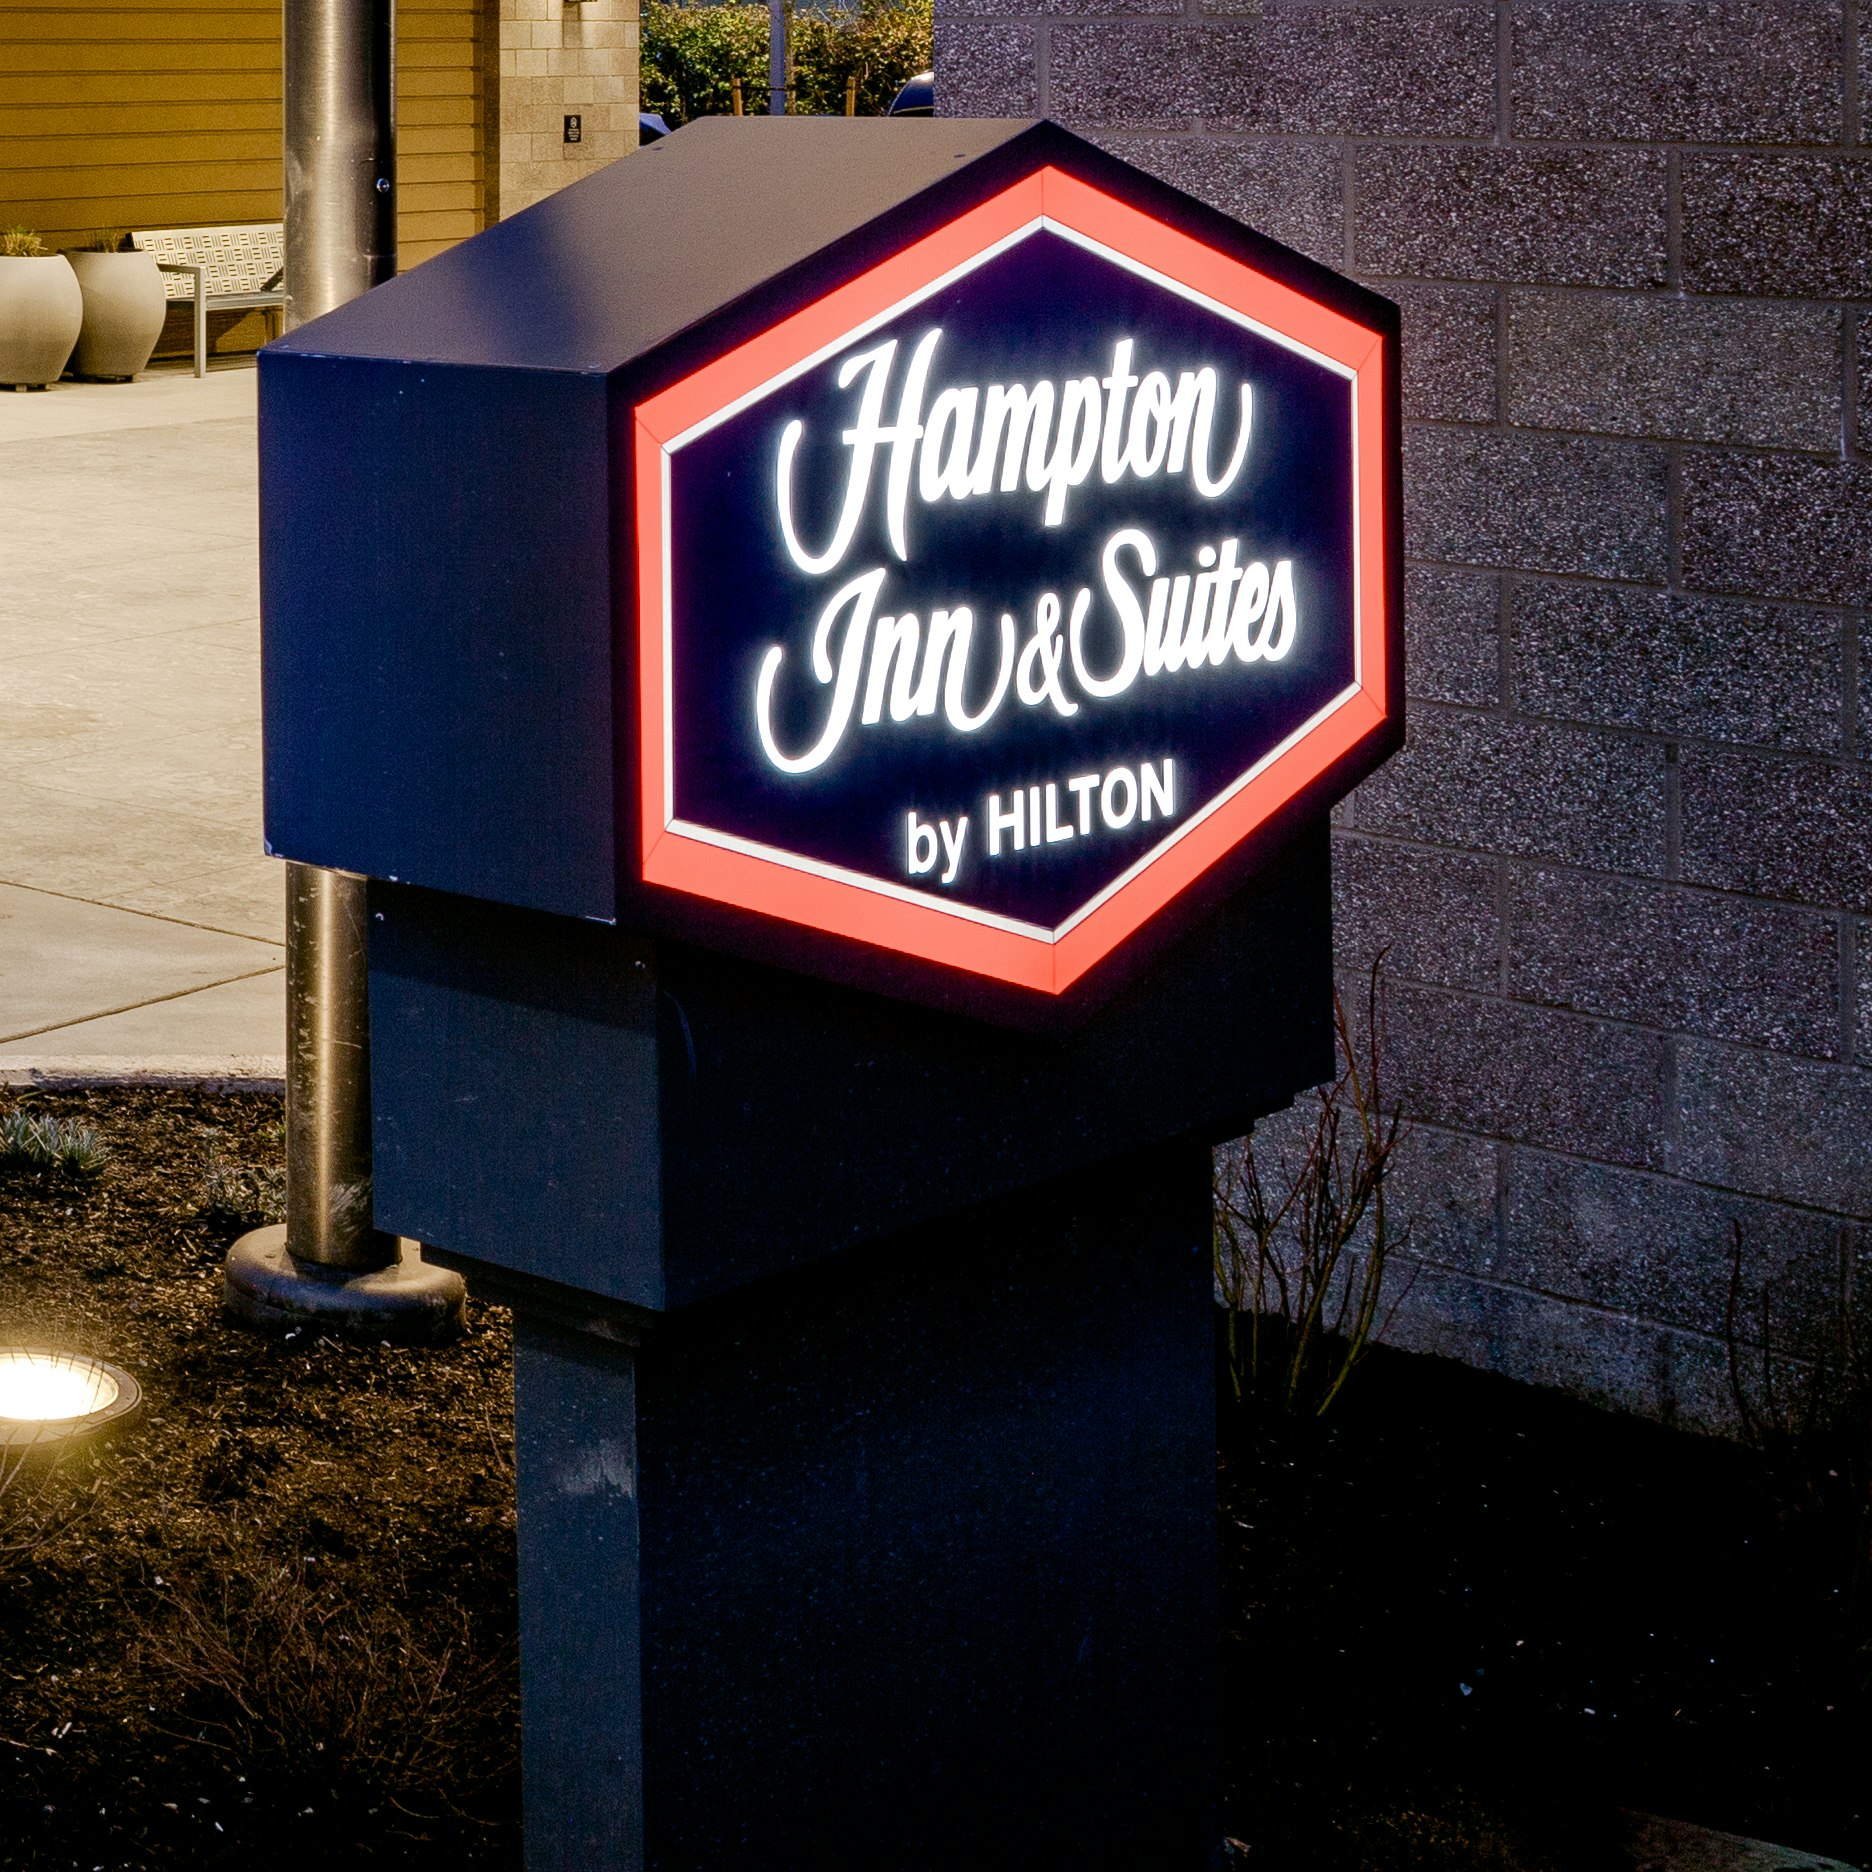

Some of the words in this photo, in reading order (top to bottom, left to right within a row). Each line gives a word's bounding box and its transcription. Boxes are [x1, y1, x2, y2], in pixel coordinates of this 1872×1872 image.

[777, 328, 1253, 576] Hampton
[756, 568, 1014, 775] Inn
[1016, 593, 1079, 717] &
[1070, 528, 1298, 699] Suites
[906, 811, 970, 885] by
[988, 758, 1177, 857] HILTON
